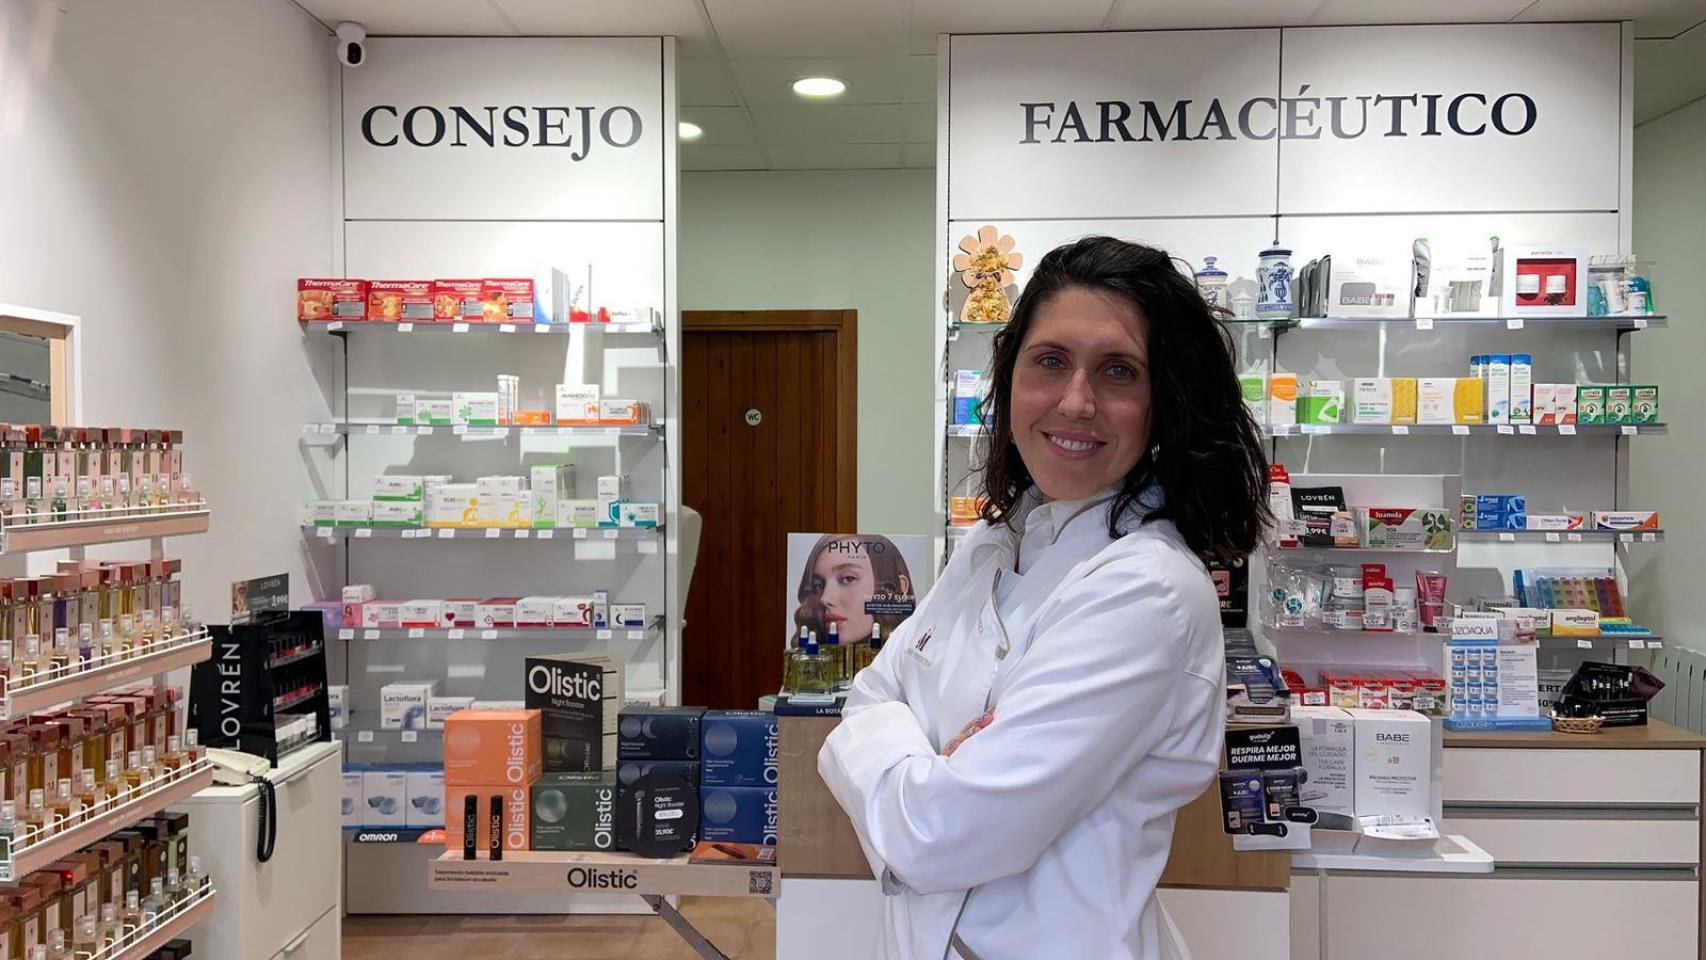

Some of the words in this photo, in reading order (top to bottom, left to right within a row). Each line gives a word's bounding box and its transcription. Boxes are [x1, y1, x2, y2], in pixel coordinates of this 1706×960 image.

[361, 105, 643, 162] CONSEJO
[1019, 84, 1538, 144] FARMACÉUTICO
[304, 280, 359, 288] ThermaCare
[371, 281, 427, 290] ThermaCare
[485, 280, 530, 289] ThermaCare
[747, 412, 760, 421] WC
[828, 541, 885, 554] PHYTO
[529, 666, 602, 701] Olistic
[216, 643, 242, 751] LOVRÉN
[384, 695, 422, 703] Lactoflora
[825, 706, 842, 714] BOTÁ
[507, 723, 525, 783] Olistic
[763, 724, 778, 784] Olistic
[1230, 746, 1265, 756] RESPIRA
[1266, 744, 1296, 754] MEJOR
[1231, 755, 1265, 764] DUERME
[1266, 753, 1297, 762] MEJOR
[508, 789, 525, 849] Olistic
[594, 788, 612, 848] Olistic
[491, 815, 500, 849] Olistic
[567, 867, 638, 889] Olistic
